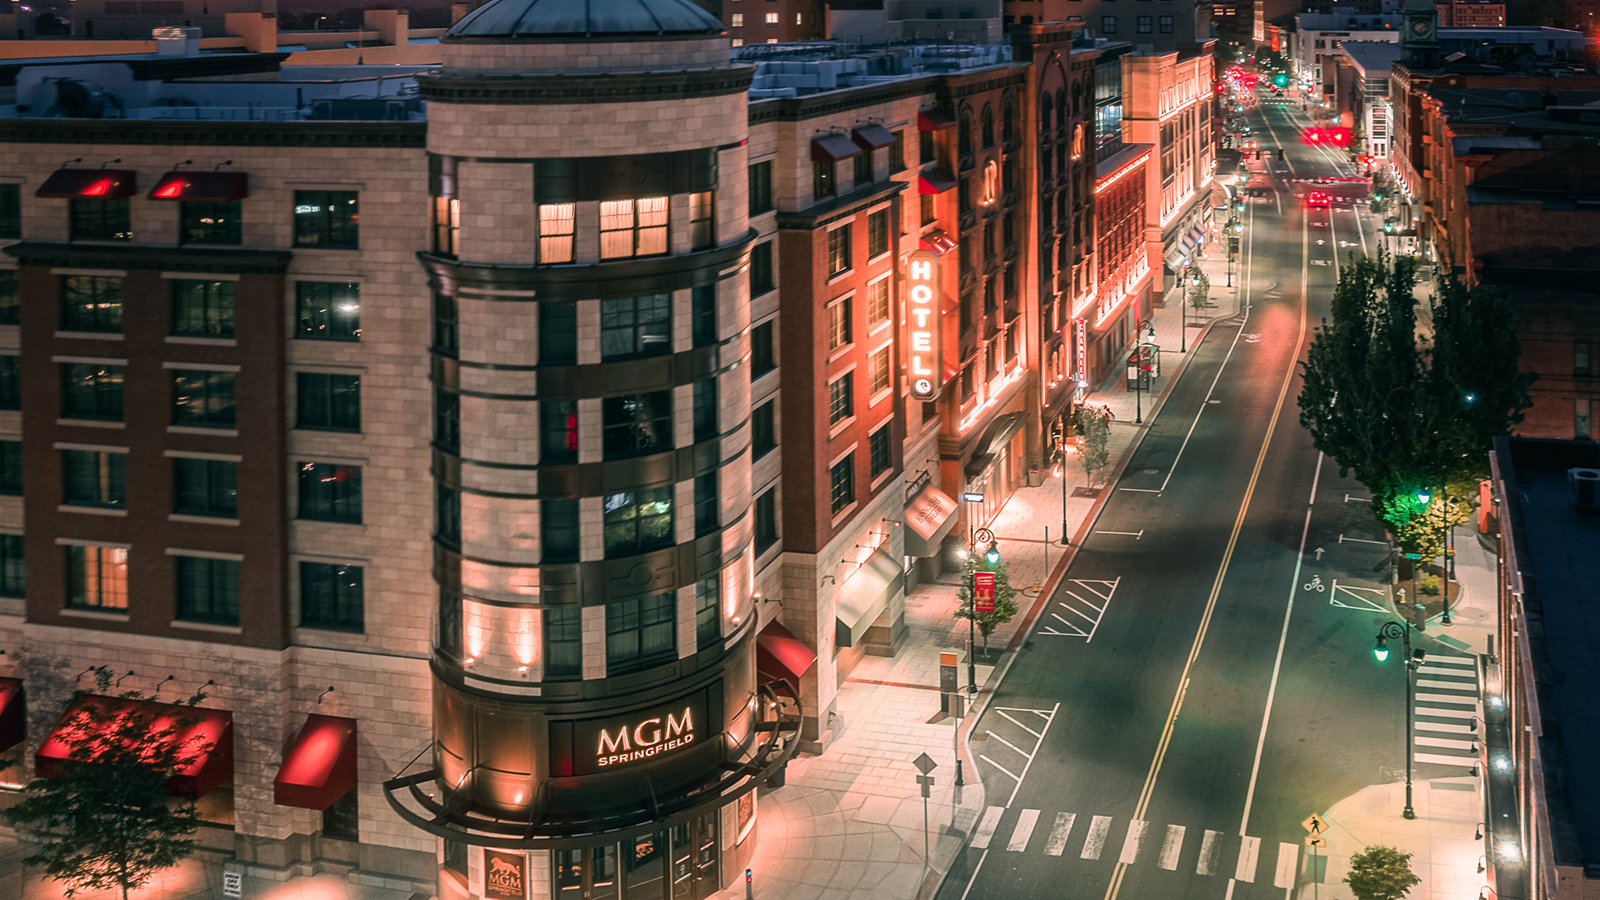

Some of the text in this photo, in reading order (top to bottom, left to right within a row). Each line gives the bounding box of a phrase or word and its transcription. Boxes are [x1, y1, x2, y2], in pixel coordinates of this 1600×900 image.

[1310, 259, 1333, 267] ONLY
[911, 260, 932, 376] HOTEL
[596, 706, 694, 755] MGM
[597, 733, 695, 766] SPRINGFIELD
[488, 872, 522, 889] MGM
